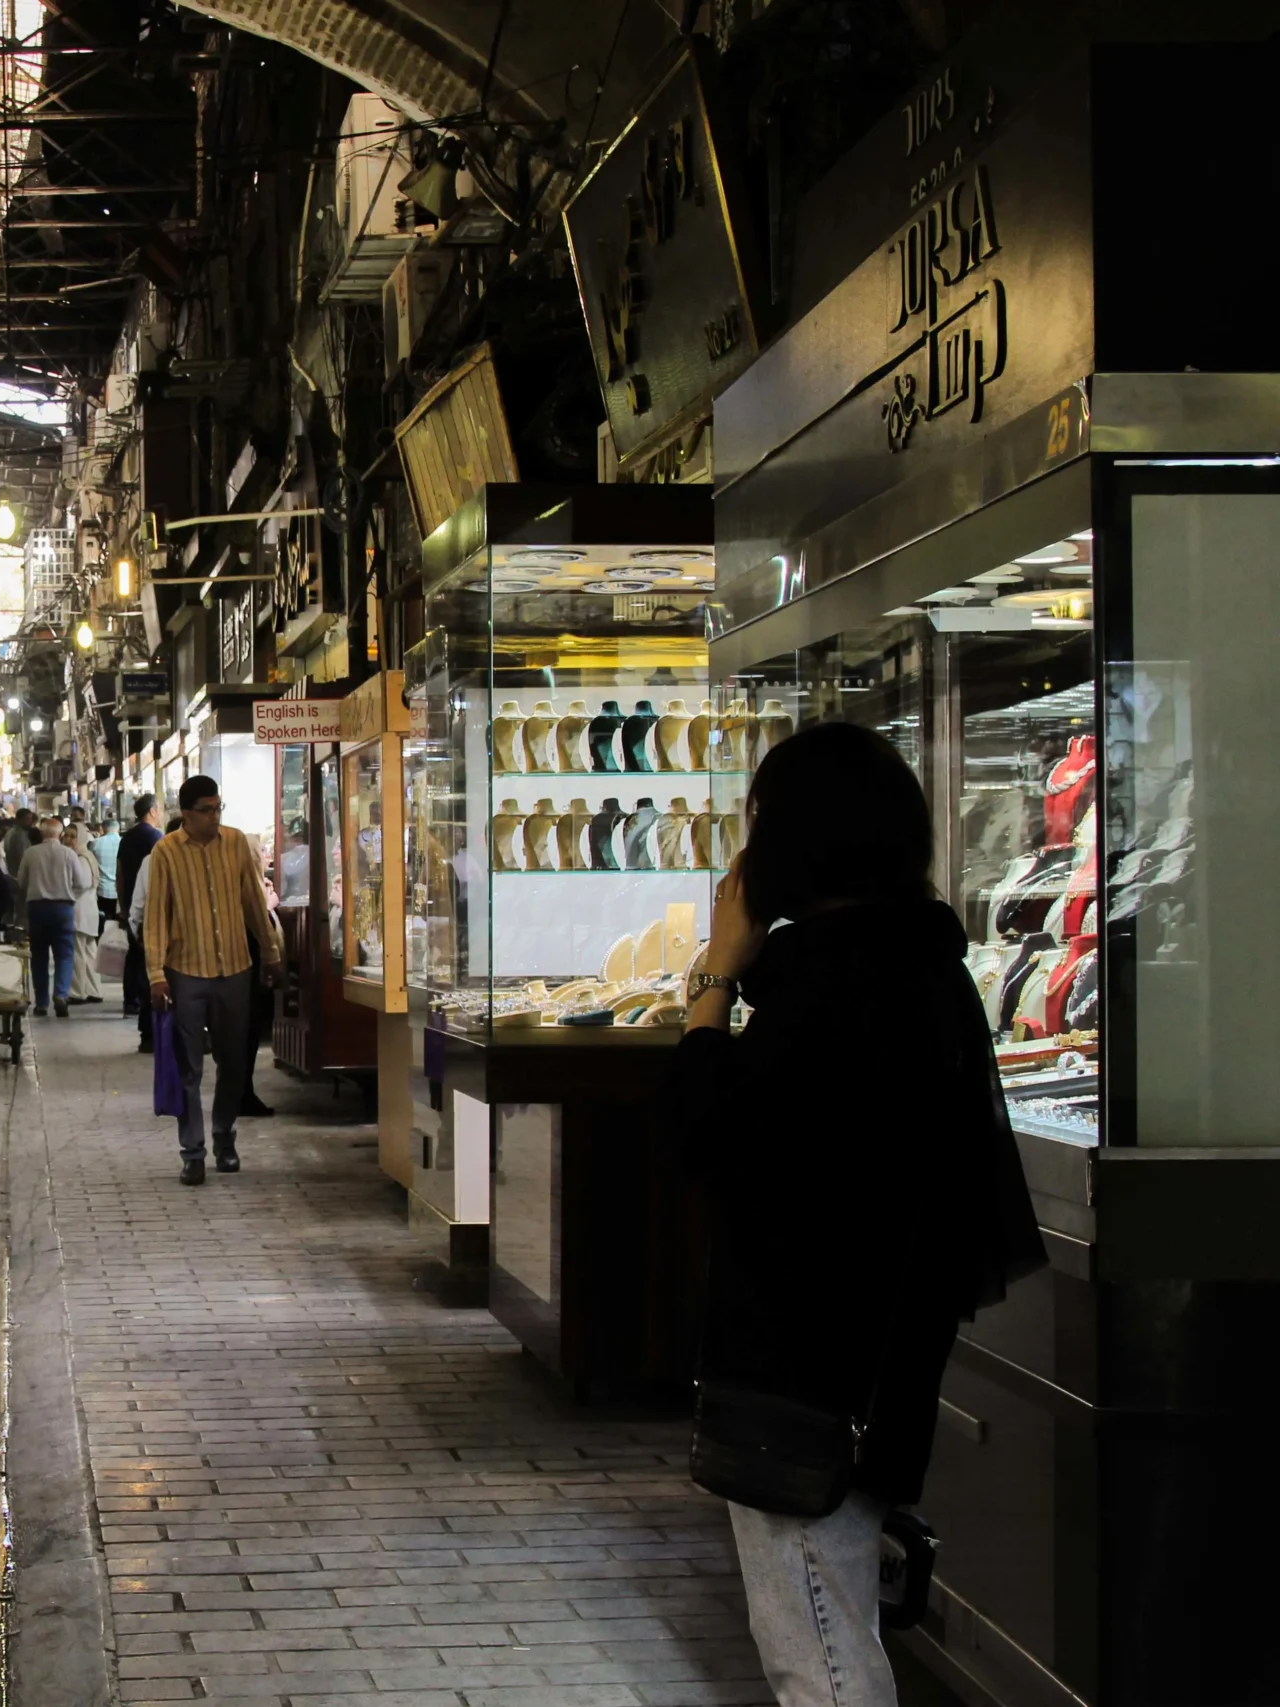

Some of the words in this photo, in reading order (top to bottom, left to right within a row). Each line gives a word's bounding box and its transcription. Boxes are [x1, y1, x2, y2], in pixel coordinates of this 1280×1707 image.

[1045, 397, 1071, 460] 25
[256, 704, 304, 722] English
[308, 704, 319, 718] is
[257, 724, 307, 742] Spoken
[311, 723, 341, 738] Here
